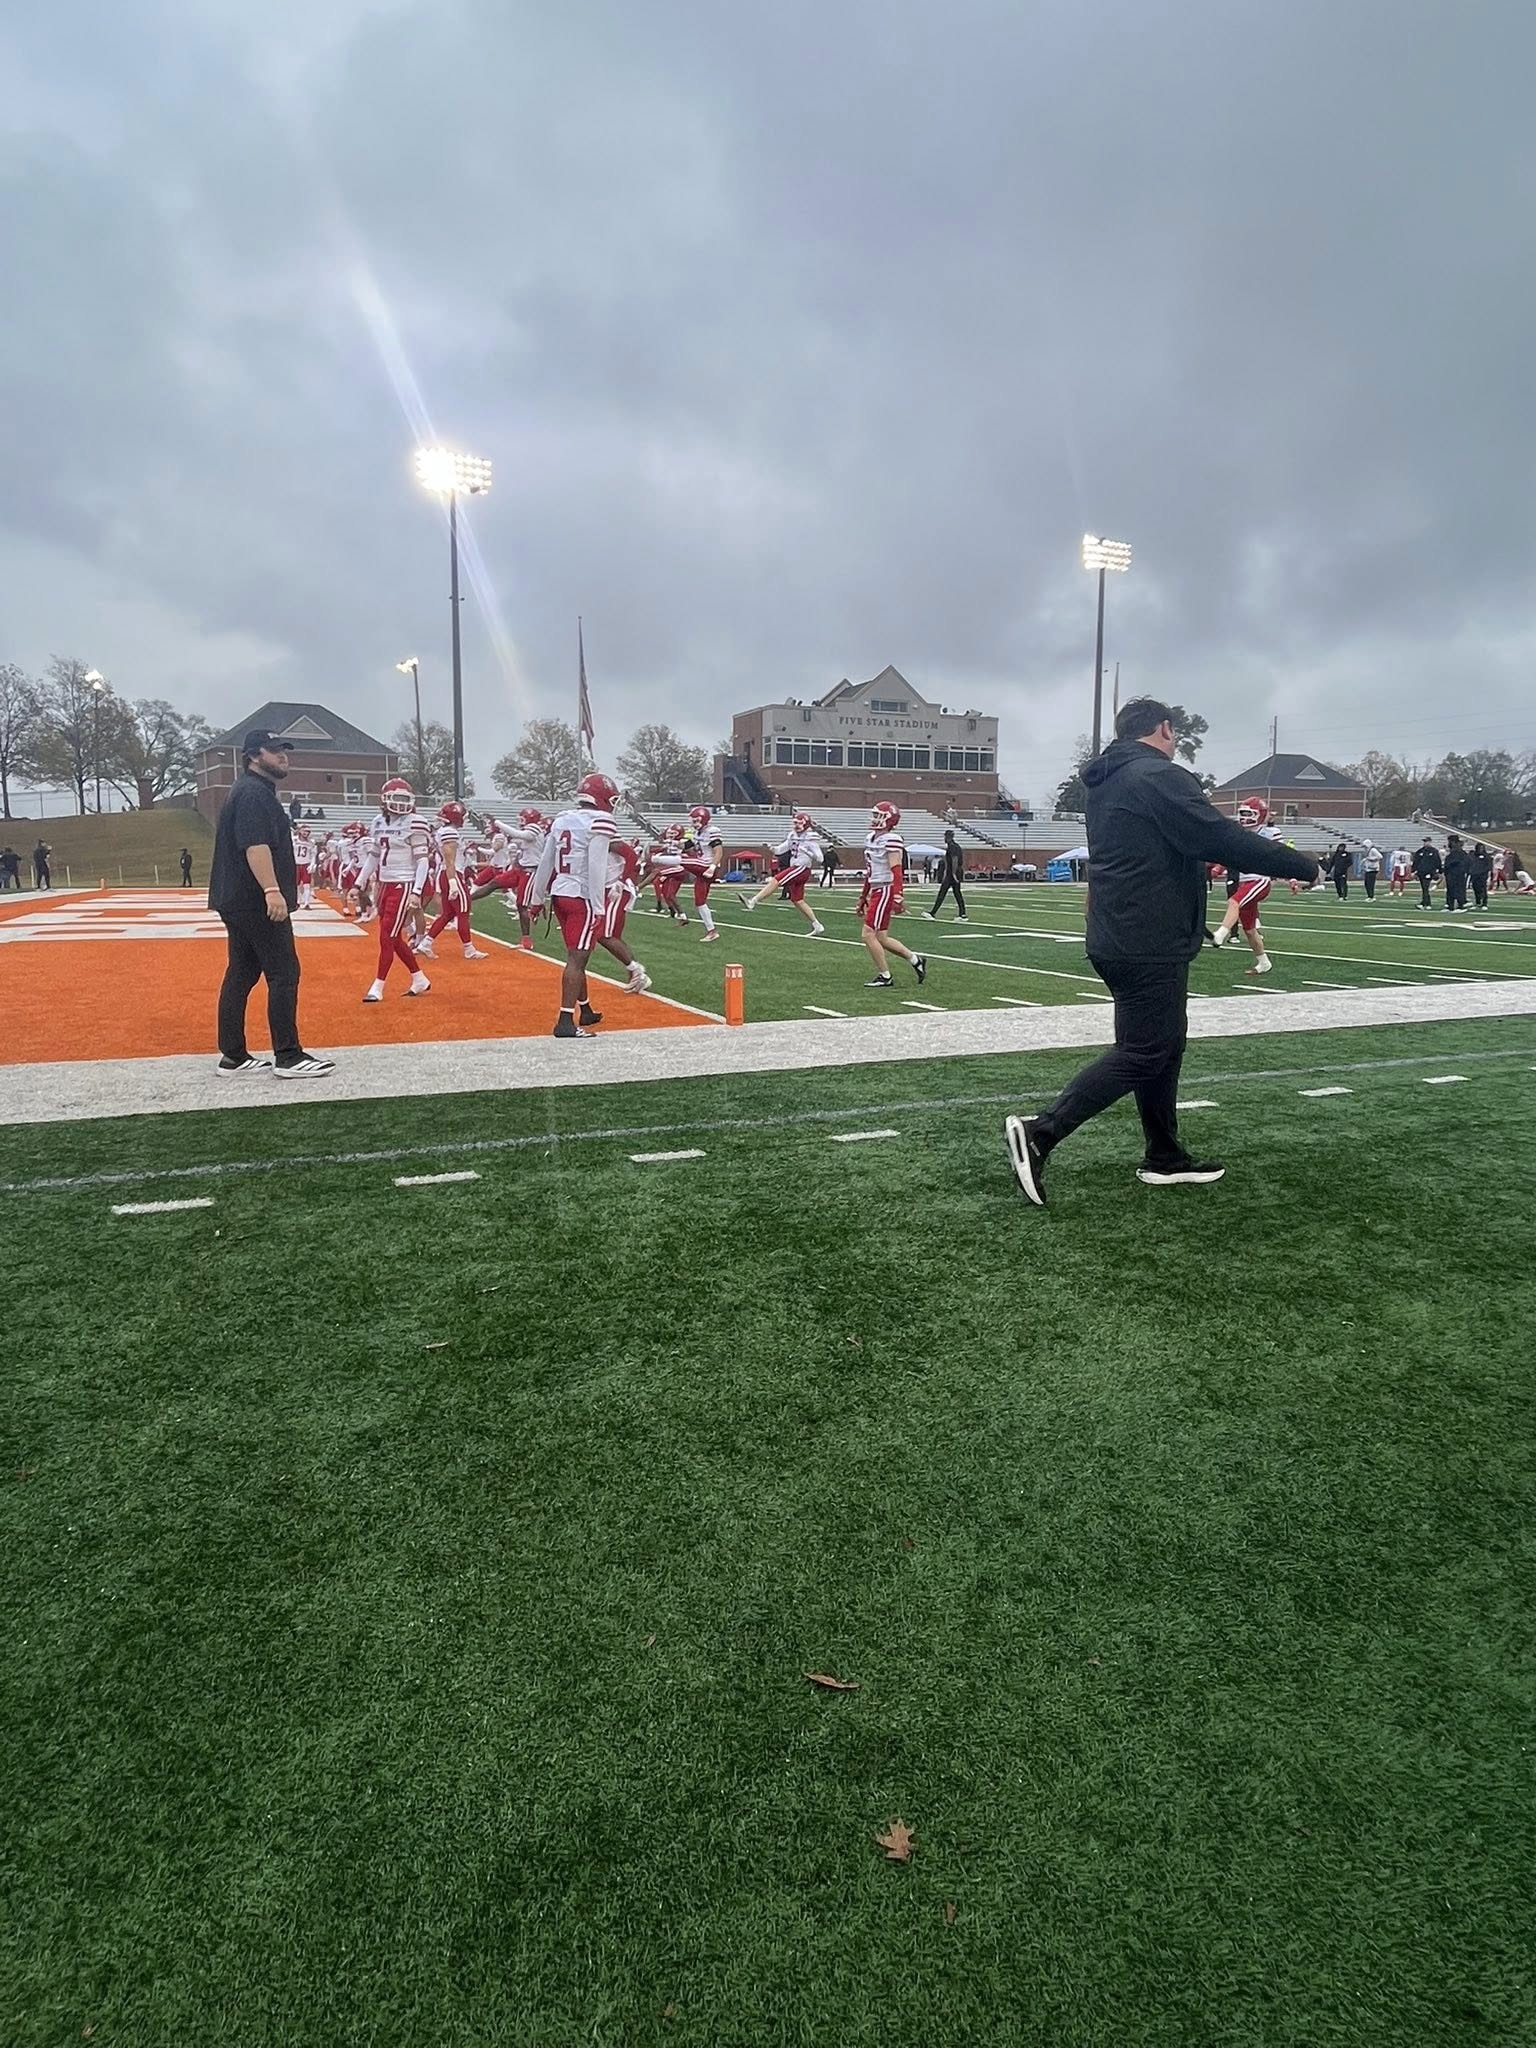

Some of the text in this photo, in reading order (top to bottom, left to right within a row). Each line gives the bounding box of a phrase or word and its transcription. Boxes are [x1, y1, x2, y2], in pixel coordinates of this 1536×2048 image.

[839, 716, 939, 730] FIVE STAR STADIUM
[296, 844, 308, 859] 13
[380, 836, 391, 867] 7
[559, 830, 572, 874] 2
